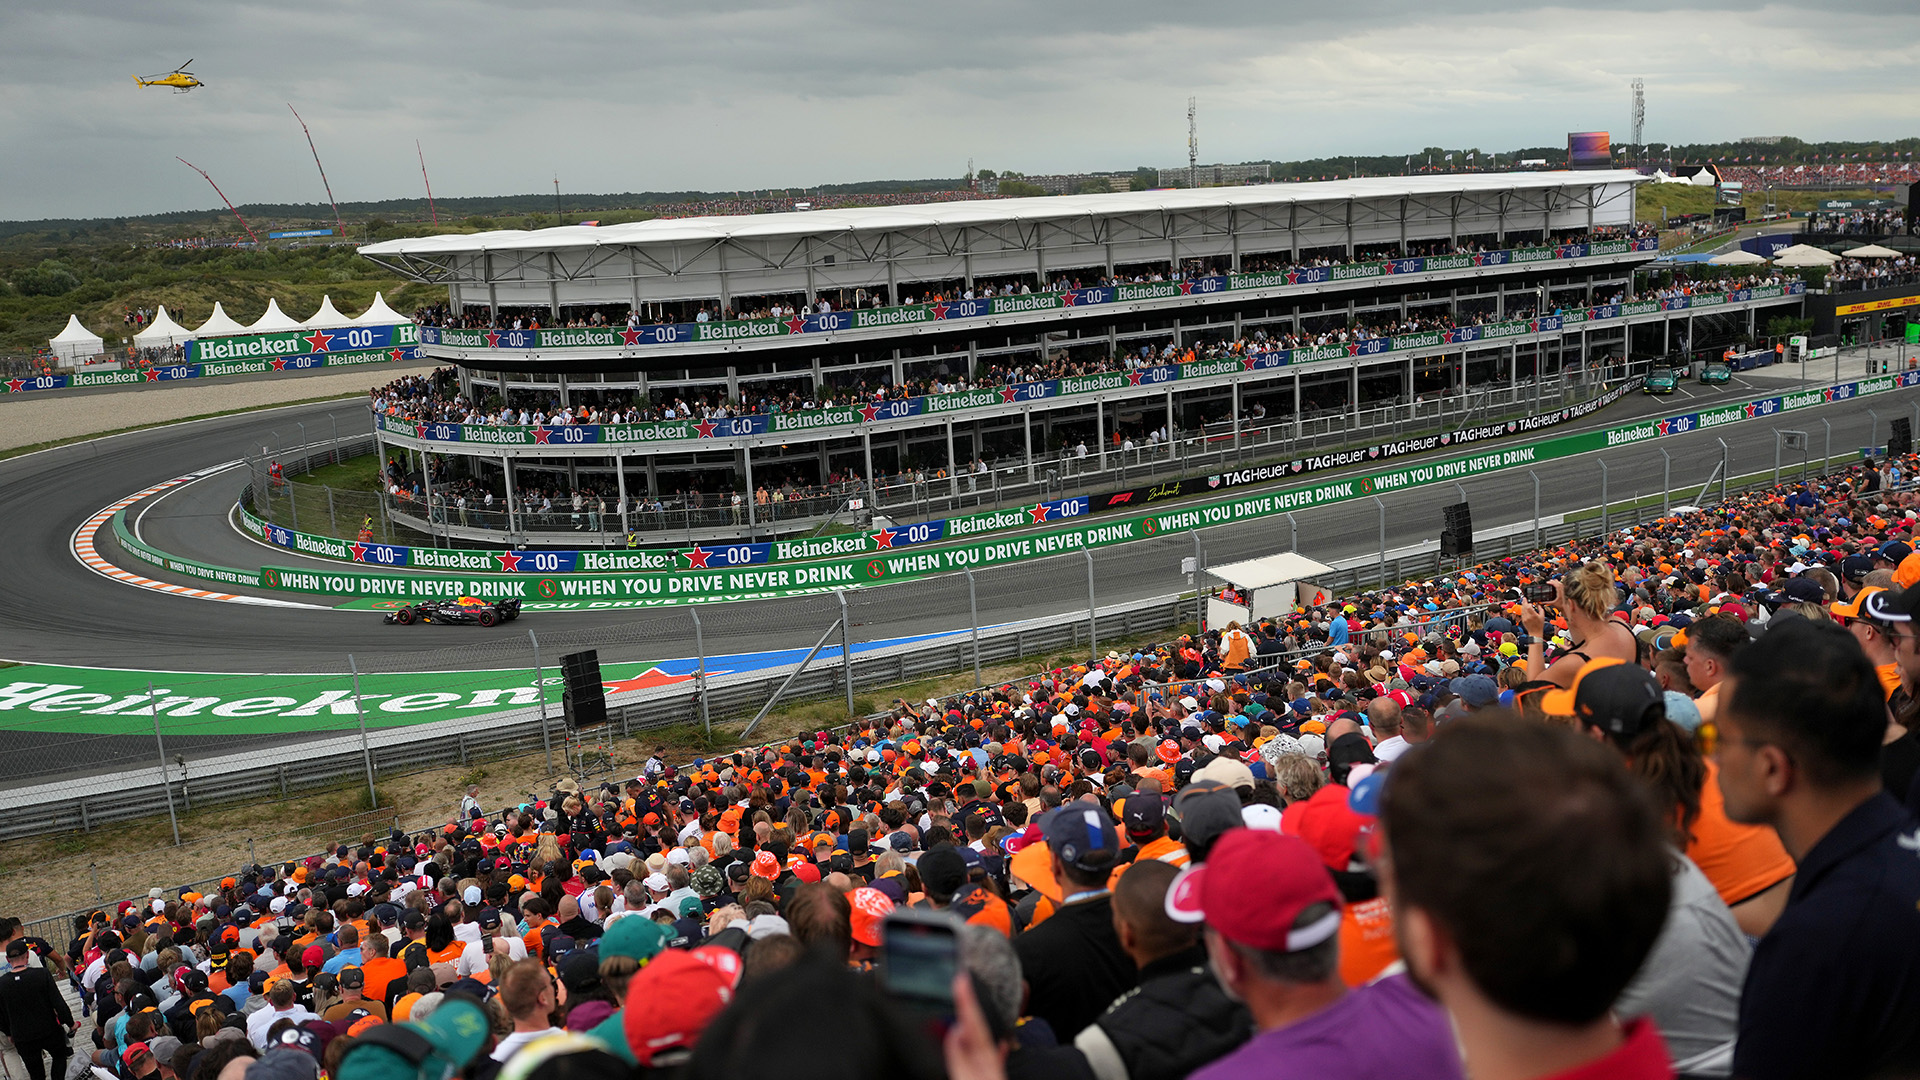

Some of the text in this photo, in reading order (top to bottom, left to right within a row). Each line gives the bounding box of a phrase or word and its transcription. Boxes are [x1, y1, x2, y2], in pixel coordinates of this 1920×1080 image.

[1827, 200, 1852, 209] allwyn
[1512, 250, 1552, 262] Heineken
[1590, 242, 1626, 255] Heineken
[1426, 256, 1470, 270] Heineken
[1230, 274, 1282, 289] Heineken
[1333, 265, 1380, 280] Heineken
[1118, 284, 1174, 301] Heineken
[1692, 294, 1724, 307] Heineken
[1751, 286, 1781, 300] Heineken
[994, 296, 1056, 313] Heineken
[1621, 302, 1657, 316] Heineken
[857, 309, 926, 326] Heineken
[441, 330, 482, 346] Heineken
[541, 330, 614, 346] Heineken
[700, 322, 779, 340] Heineken
[1484, 324, 1526, 338] Heineken
[199, 338, 299, 360] Heineken
[1392, 334, 1438, 350] Heineken
[328, 352, 386, 366] Heineken
[1292, 348, 1343, 364] Heineken
[204, 361, 266, 376] Heineken
[1182, 360, 1238, 378] Heineken
[72, 372, 138, 386] Heineken
[1062, 376, 1122, 394] Heineken
[1859, 379, 1893, 394] Heineken
[927, 392, 995, 412] Heineken
[1783, 392, 1822, 410] Heineken
[385, 417, 414, 436] Heineken
[775, 410, 854, 430] Heineken
[1700, 410, 1742, 428] Heineken
[464, 426, 526, 443] Heineken
[604, 424, 688, 442] Heineken
[1608, 426, 1655, 446] Heineken
[1374, 448, 1535, 490] WHEN YOU DRIVE NEVER DRINK
[1158, 483, 1353, 532] WHEN YOU DRIVE NEVER DRINK
[949, 512, 1024, 536] Heineken
[296, 534, 346, 558] Heineken
[776, 537, 867, 560] Heineken
[888, 524, 1133, 574] WHEN YOU DRIVE NEVER DRINK
[412, 549, 492, 569] Heineken
[170, 562, 260, 586] WHEN YOU DRIVE NEVER DRINK
[560, 564, 854, 596] WHEN YOU DRIVE NEVER DRINK
[280, 572, 526, 597] WHEN YOU DRIVE NEVER DRINK
[588, 599, 678, 608] DRIVE
[688, 592, 778, 603] NEVER
[784, 583, 865, 596] DRINK
[0, 682, 548, 716] Heineken
